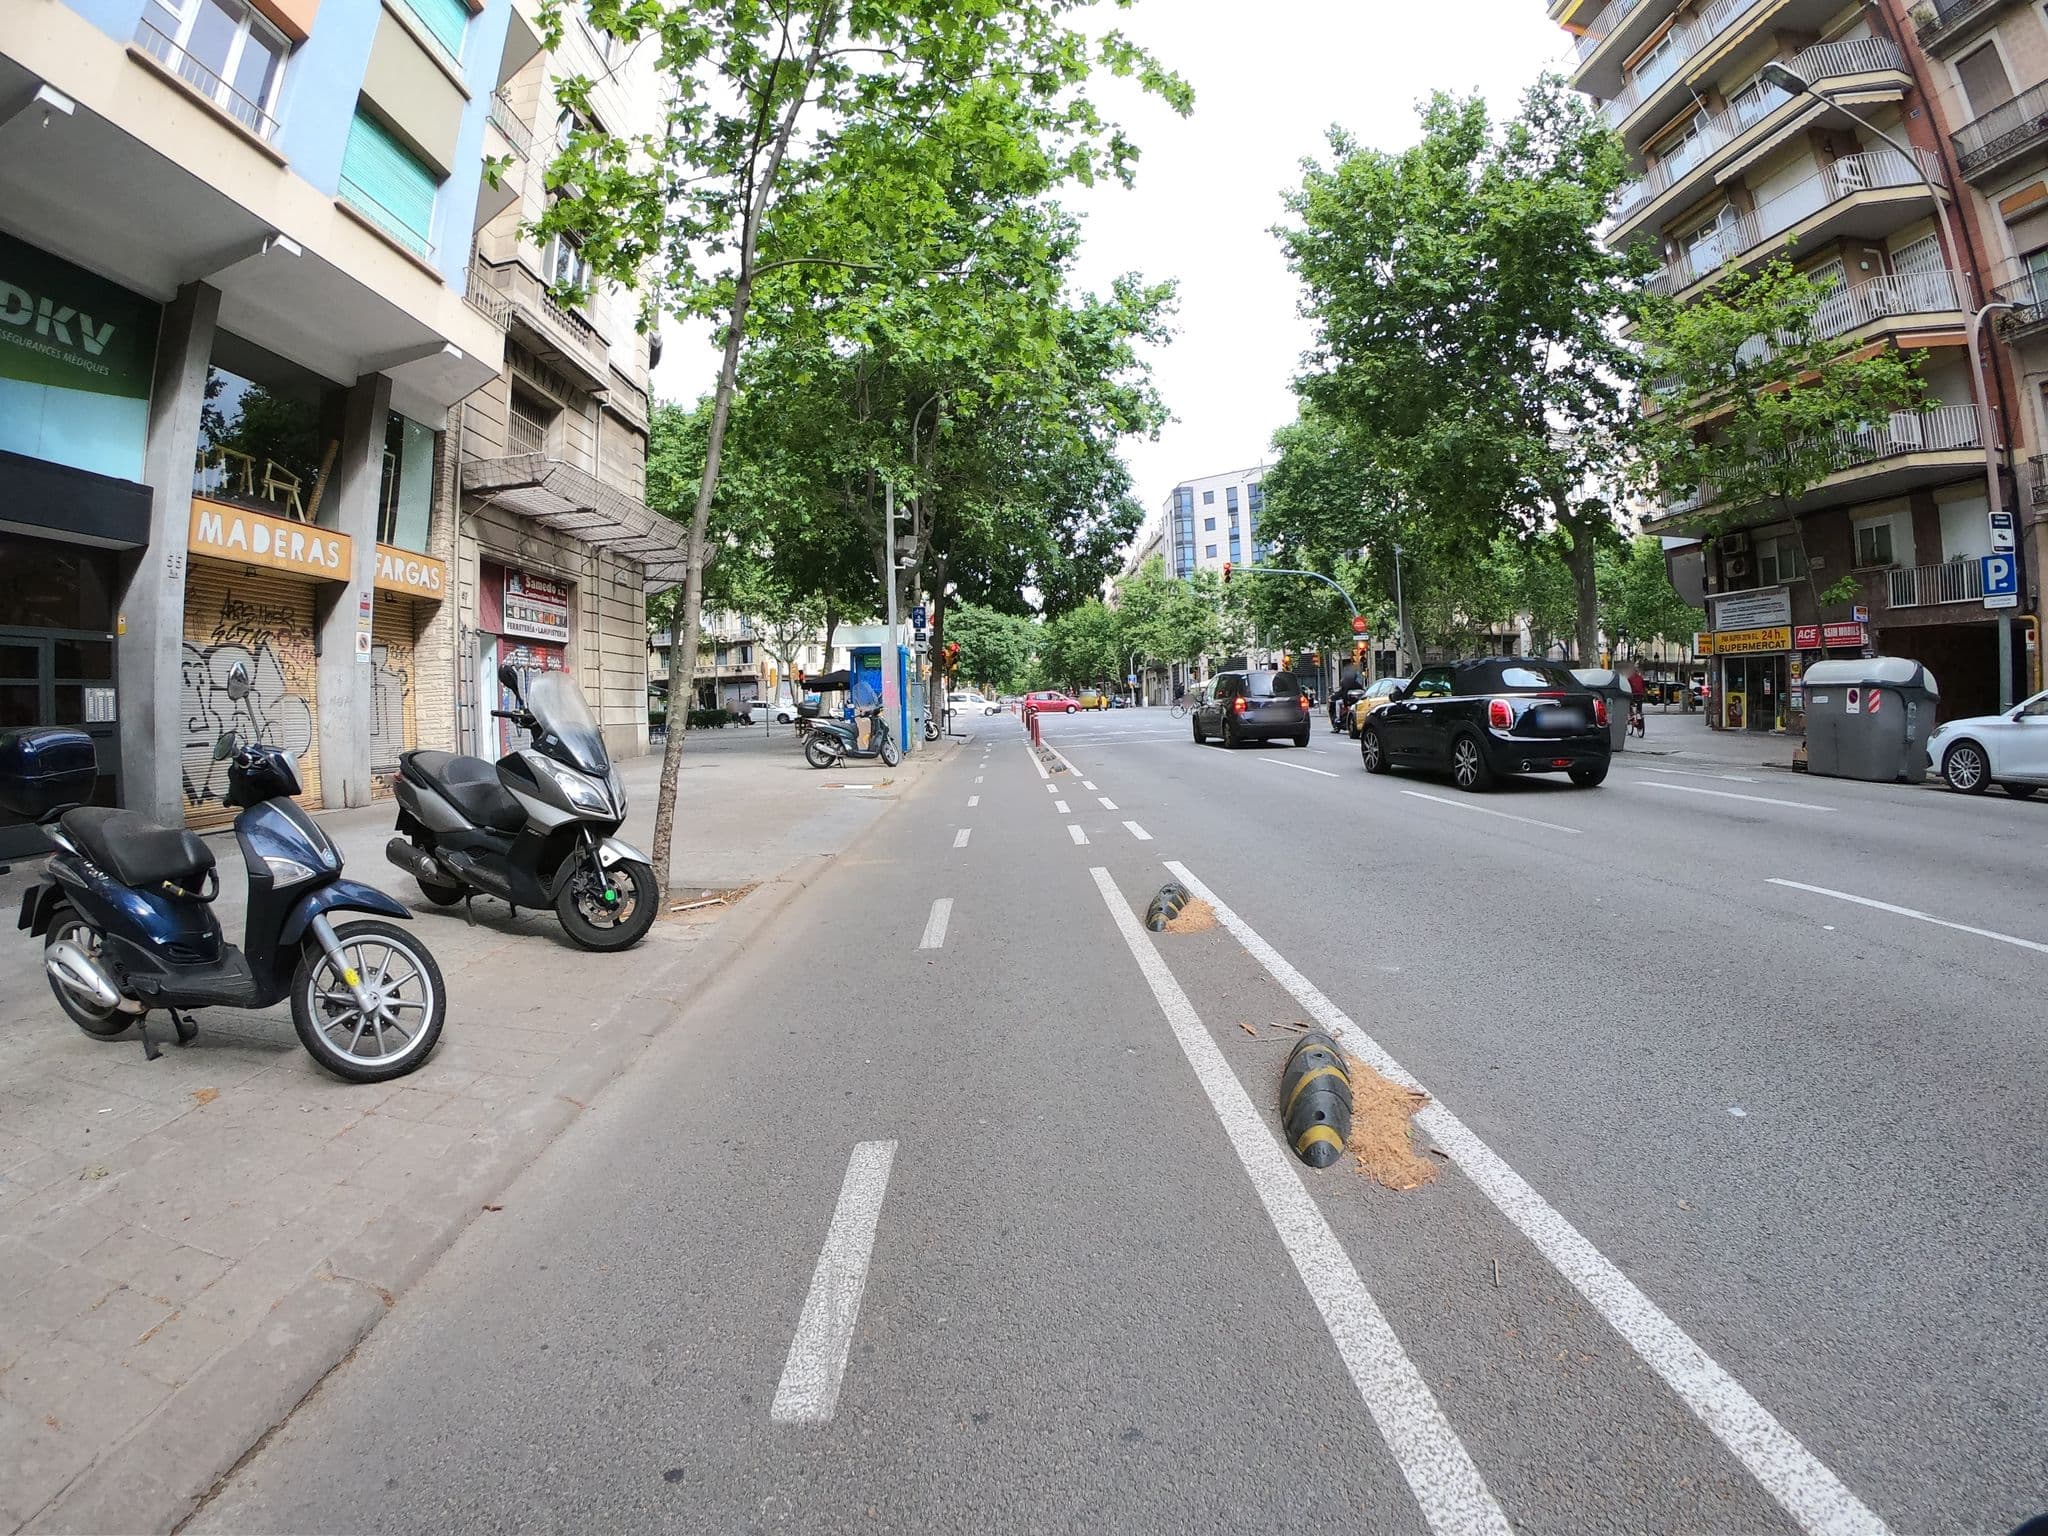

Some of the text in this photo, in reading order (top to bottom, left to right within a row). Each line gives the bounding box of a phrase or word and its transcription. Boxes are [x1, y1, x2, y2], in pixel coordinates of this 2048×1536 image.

[0, 280, 116, 356] DKV
[198, 511, 340, 569] MADERAS
[375, 552, 441, 590] FARGAS
[1987, 558, 2009, 590] P
[525, 575, 556, 594] Samedo
[1719, 640, 1786, 652] SUPERMERCAT
[1762, 630, 1773, 641] 24
[1797, 629, 1816, 640] ACE
